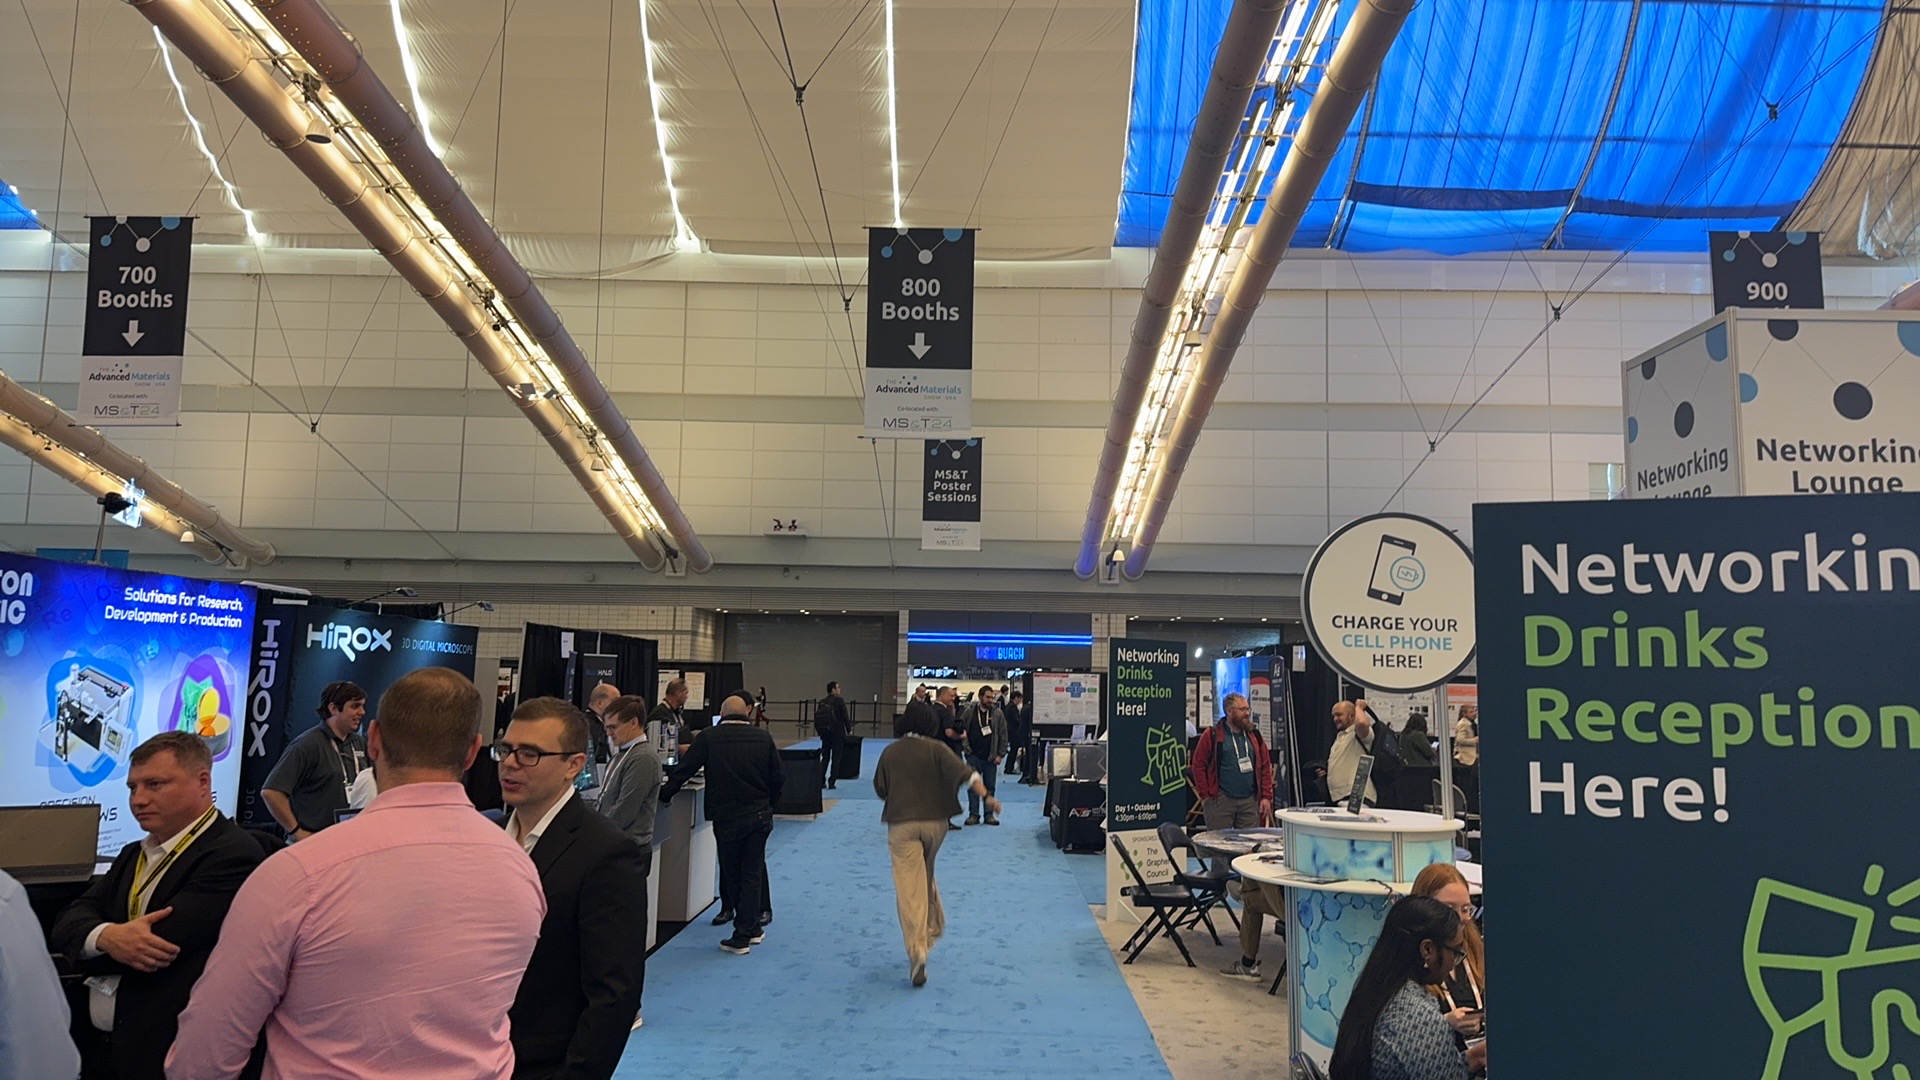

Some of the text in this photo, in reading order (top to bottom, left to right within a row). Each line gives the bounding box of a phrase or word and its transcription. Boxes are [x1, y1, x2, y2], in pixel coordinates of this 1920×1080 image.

[118, 266, 157, 285] 700
[901, 278, 941, 297] 800
[1746, 281, 1788, 301] 900
[97, 288, 174, 308] Booths
[881, 301, 960, 321] Booths
[88, 372, 171, 381] Advanced Materials
[875, 385, 962, 395] Advanced Materials
[94, 405, 160, 416] MS&T24
[882, 418, 953, 429] MS&T24
[1756, 437, 1920, 463] Networkin
[934, 470, 968, 480] MS&T
[1637, 447, 1729, 492] Networking
[933, 481, 972, 491] Poster
[1792, 470, 1904, 494] Lounge
[927, 492, 977, 503] Sessions
[1522, 532, 1920, 595] Networkin
[0, 570, 34, 597] ON
[124, 587, 243, 612] Solutions for Research,
[0, 599, 26, 625] IC
[104, 605, 242, 628] Development & Production
[1331, 615, 1458, 632] CHARGE YOUR
[401, 637, 411, 649] 3D
[412, 639, 436, 652] DIGITAL
[436, 642, 474, 655] MICROSCOPE
[1341, 634, 1453, 651] CELL PHONE
[1524, 609, 1769, 669] Drinks
[1117, 647, 1180, 667] Networking
[1372, 654, 1423, 669] HERE!
[1117, 665, 1153, 680] Drinks
[1117, 683, 1172, 700] Reception
[1116, 702, 1147, 716] Here!
[1526, 687, 1920, 758] Reception
[1529, 761, 1729, 823] Here!
[1115, 804, 1126, 814] Day
[1134, 802, 1156, 812] October
[1115, 814, 1135, 822] 4:30pm
[1138, 812, 1157, 821] 6:00pm
[1147, 848, 1158, 856] The
[1146, 869, 1169, 878] Council
